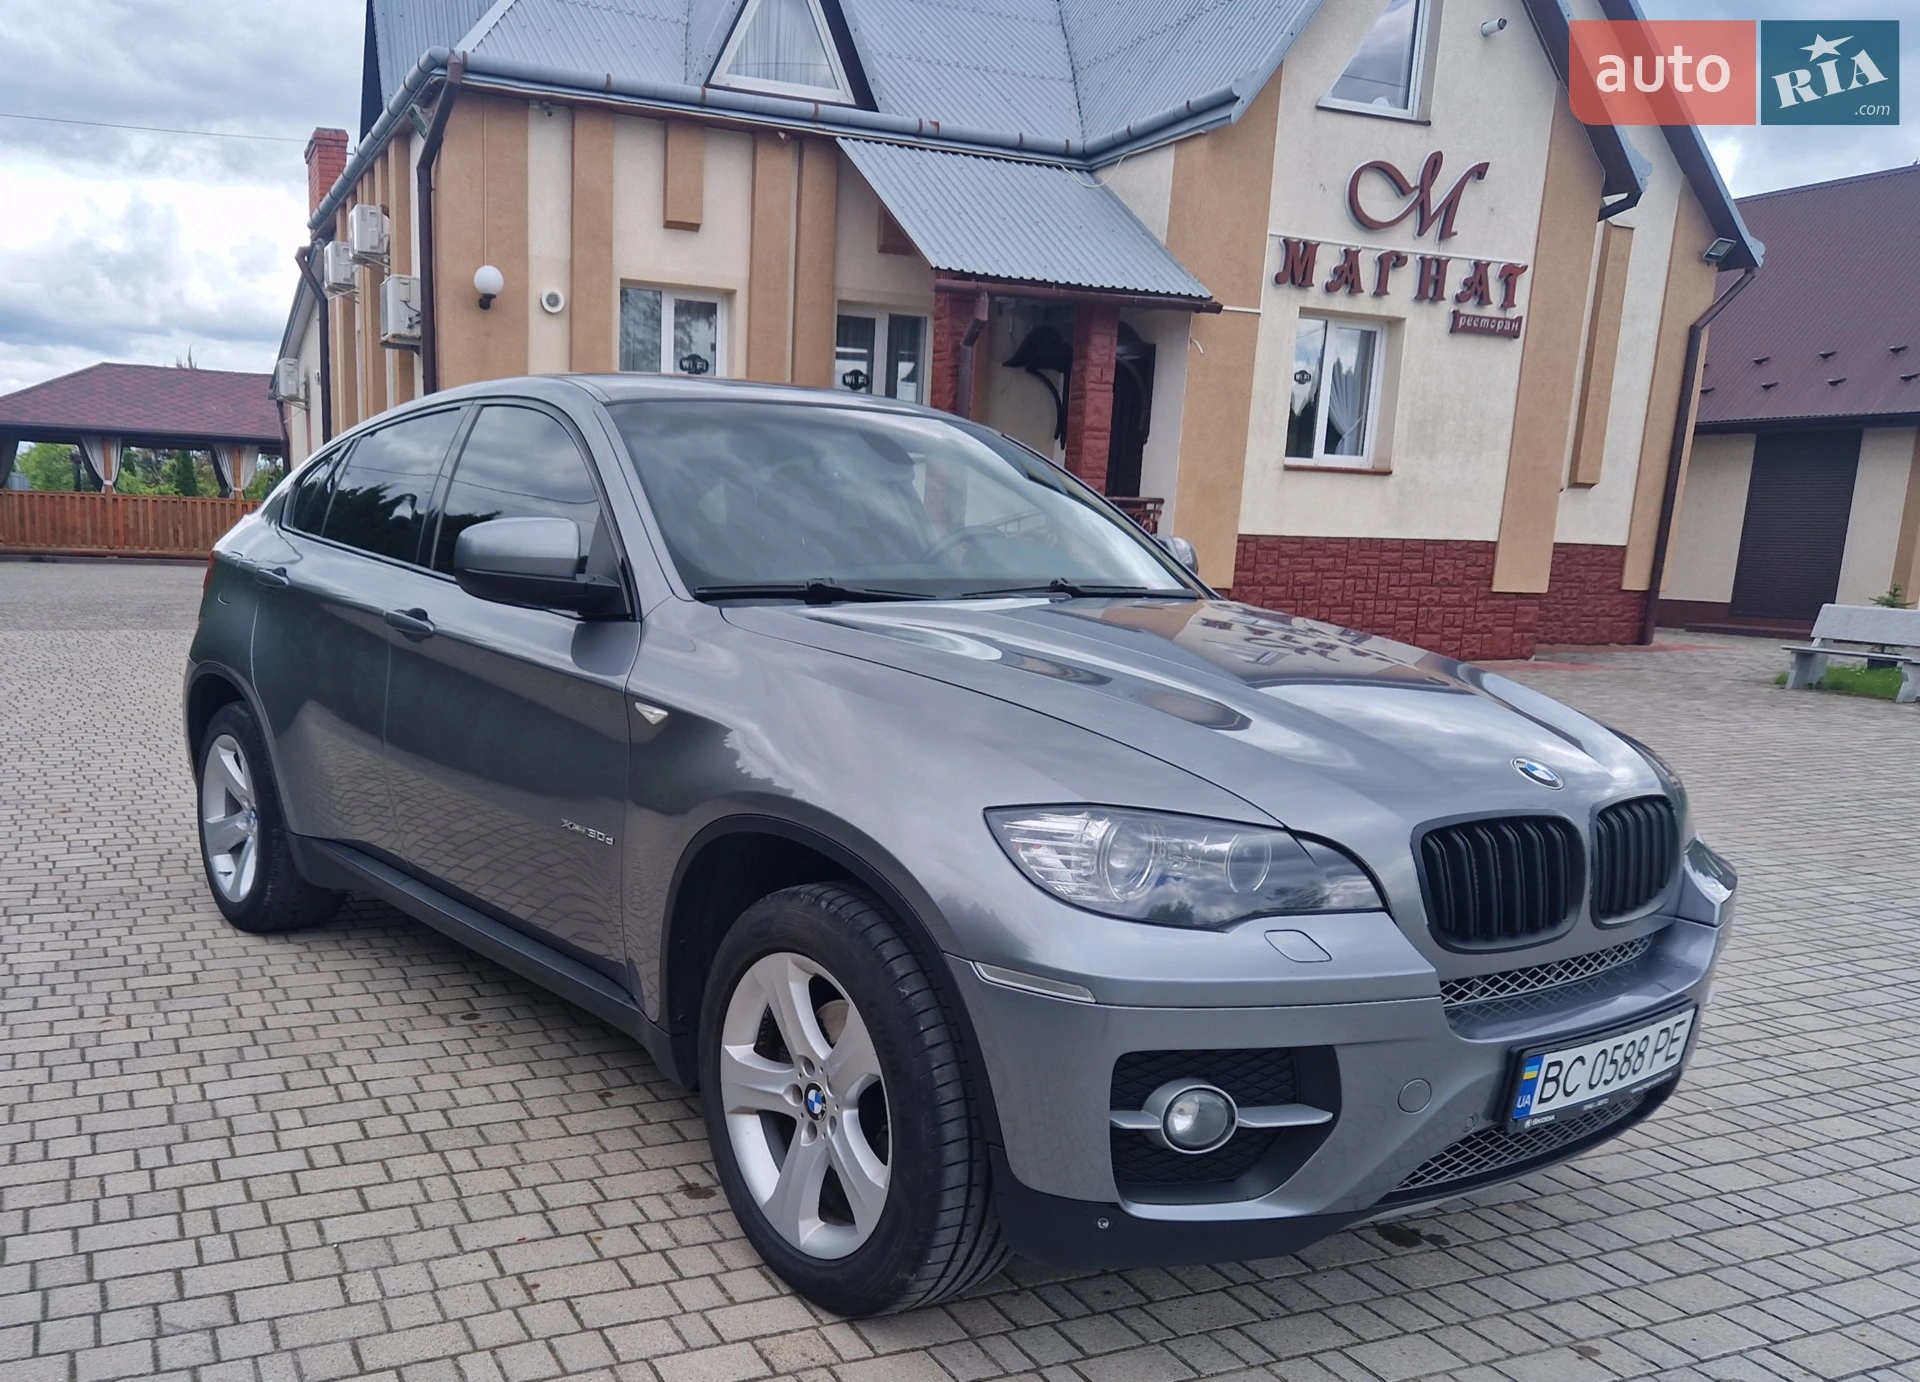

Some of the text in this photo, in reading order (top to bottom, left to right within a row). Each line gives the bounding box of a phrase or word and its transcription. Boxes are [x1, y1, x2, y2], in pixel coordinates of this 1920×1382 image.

[1272, 237, 1529, 309] МАГНАТ
[1458, 315, 1519, 332] ресторан
[1537, 1054, 1587, 1105] BC
[1588, 1034, 1650, 1090] 0588
[1649, 1018, 1687, 1069] PE
[1516, 1094, 1532, 1109] UA
